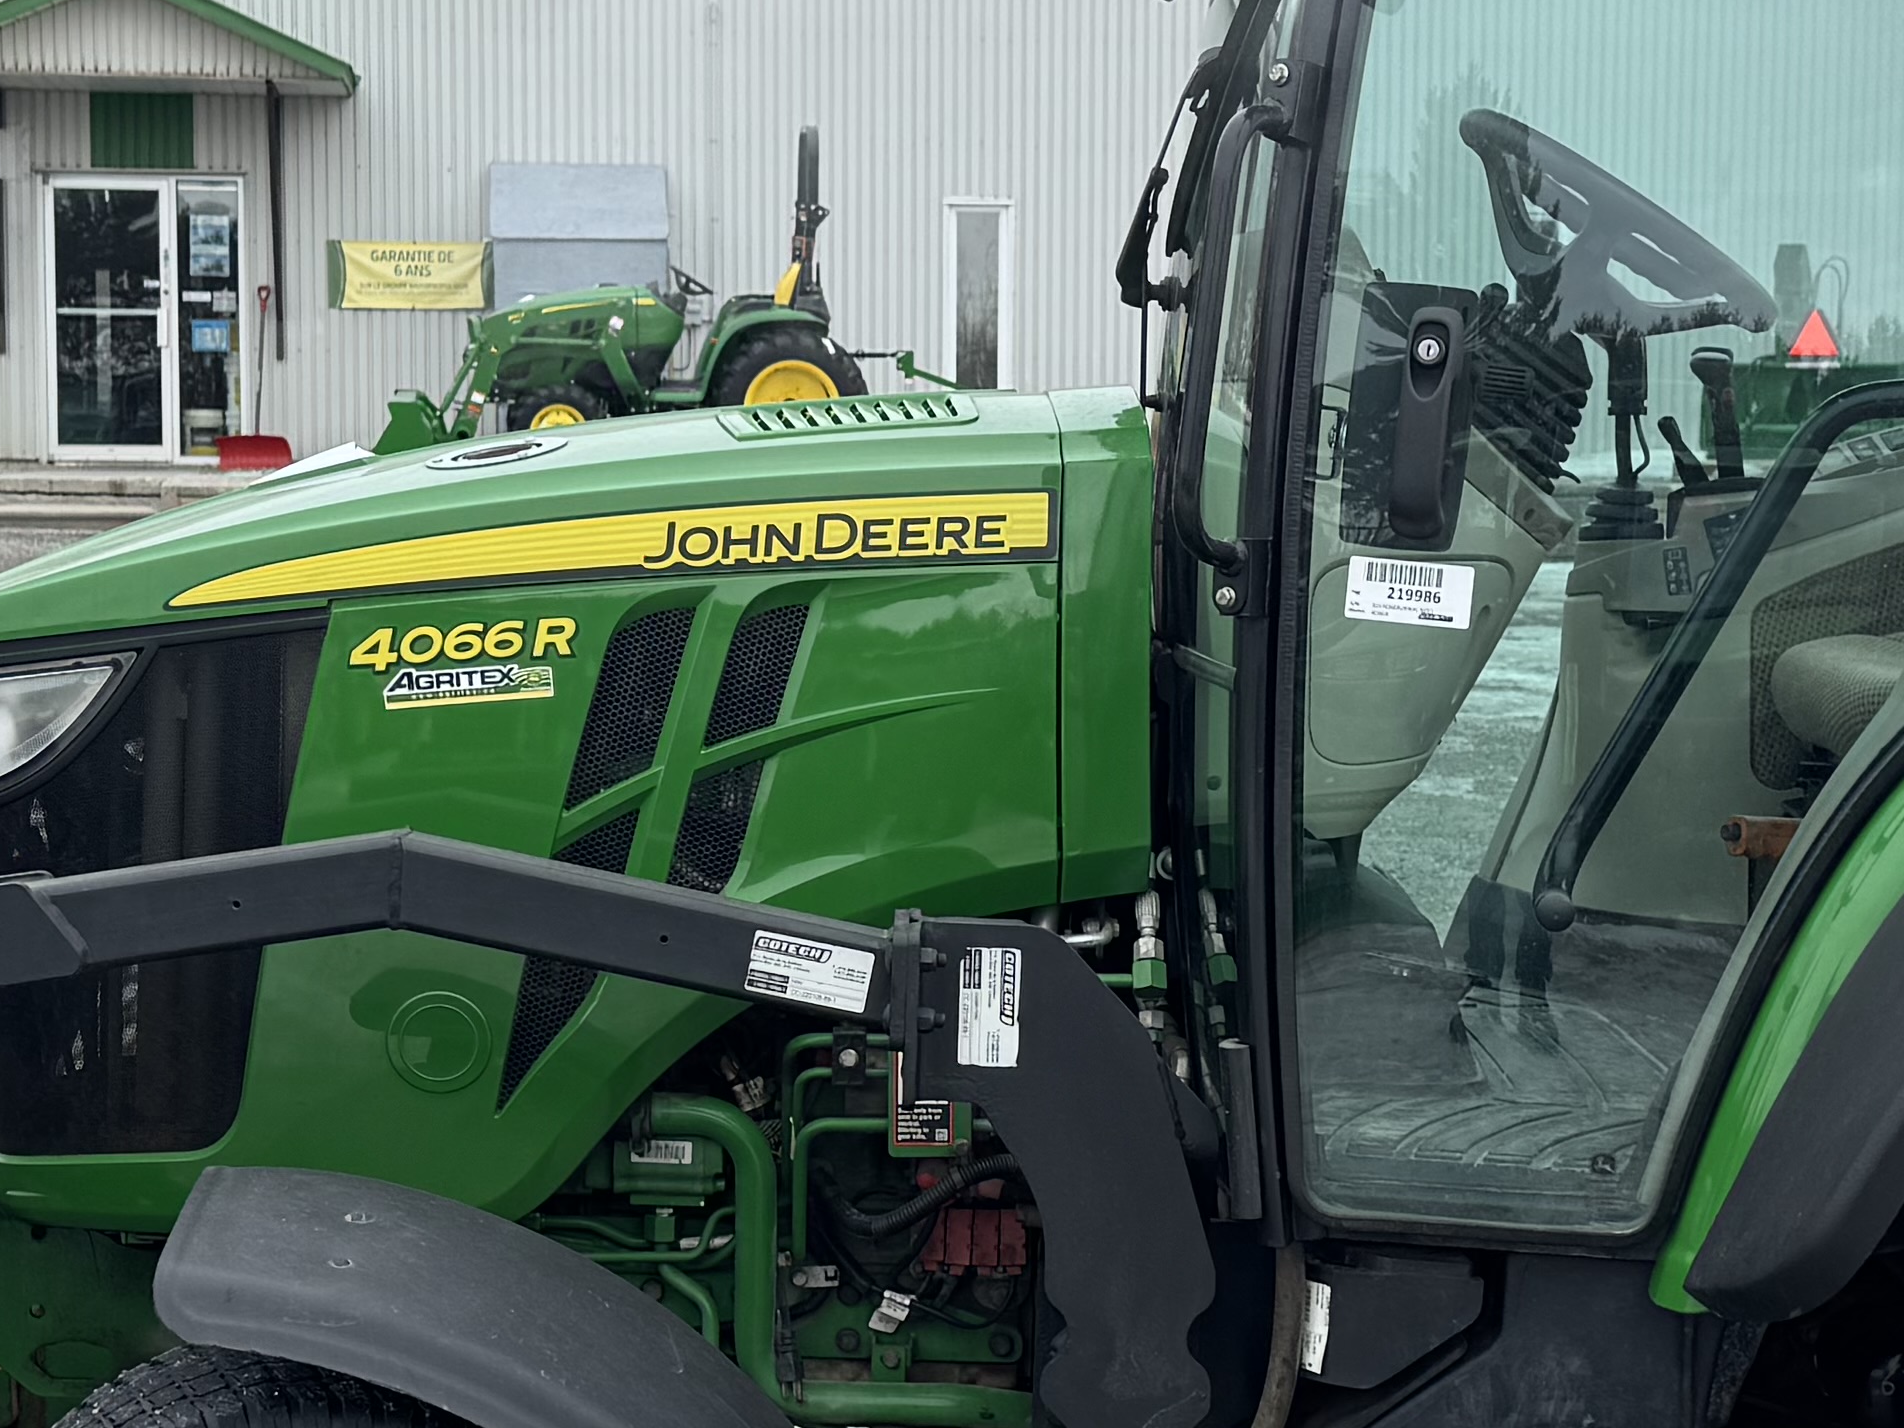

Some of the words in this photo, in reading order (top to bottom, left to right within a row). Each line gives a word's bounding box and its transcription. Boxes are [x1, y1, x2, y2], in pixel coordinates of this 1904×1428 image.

[370, 249, 434, 262] GARANTIE
[437, 251, 454, 264] DE
[394, 264, 402, 277] 6
[405, 265, 432, 278] ANS
[643, 520, 801, 564] JOHN
[814, 513, 1007, 555] DEERE
[1387, 586, 1441, 604] 219986
[387, 666, 517, 692] AGRITEX
[757, 938, 824, 961] COTECH
